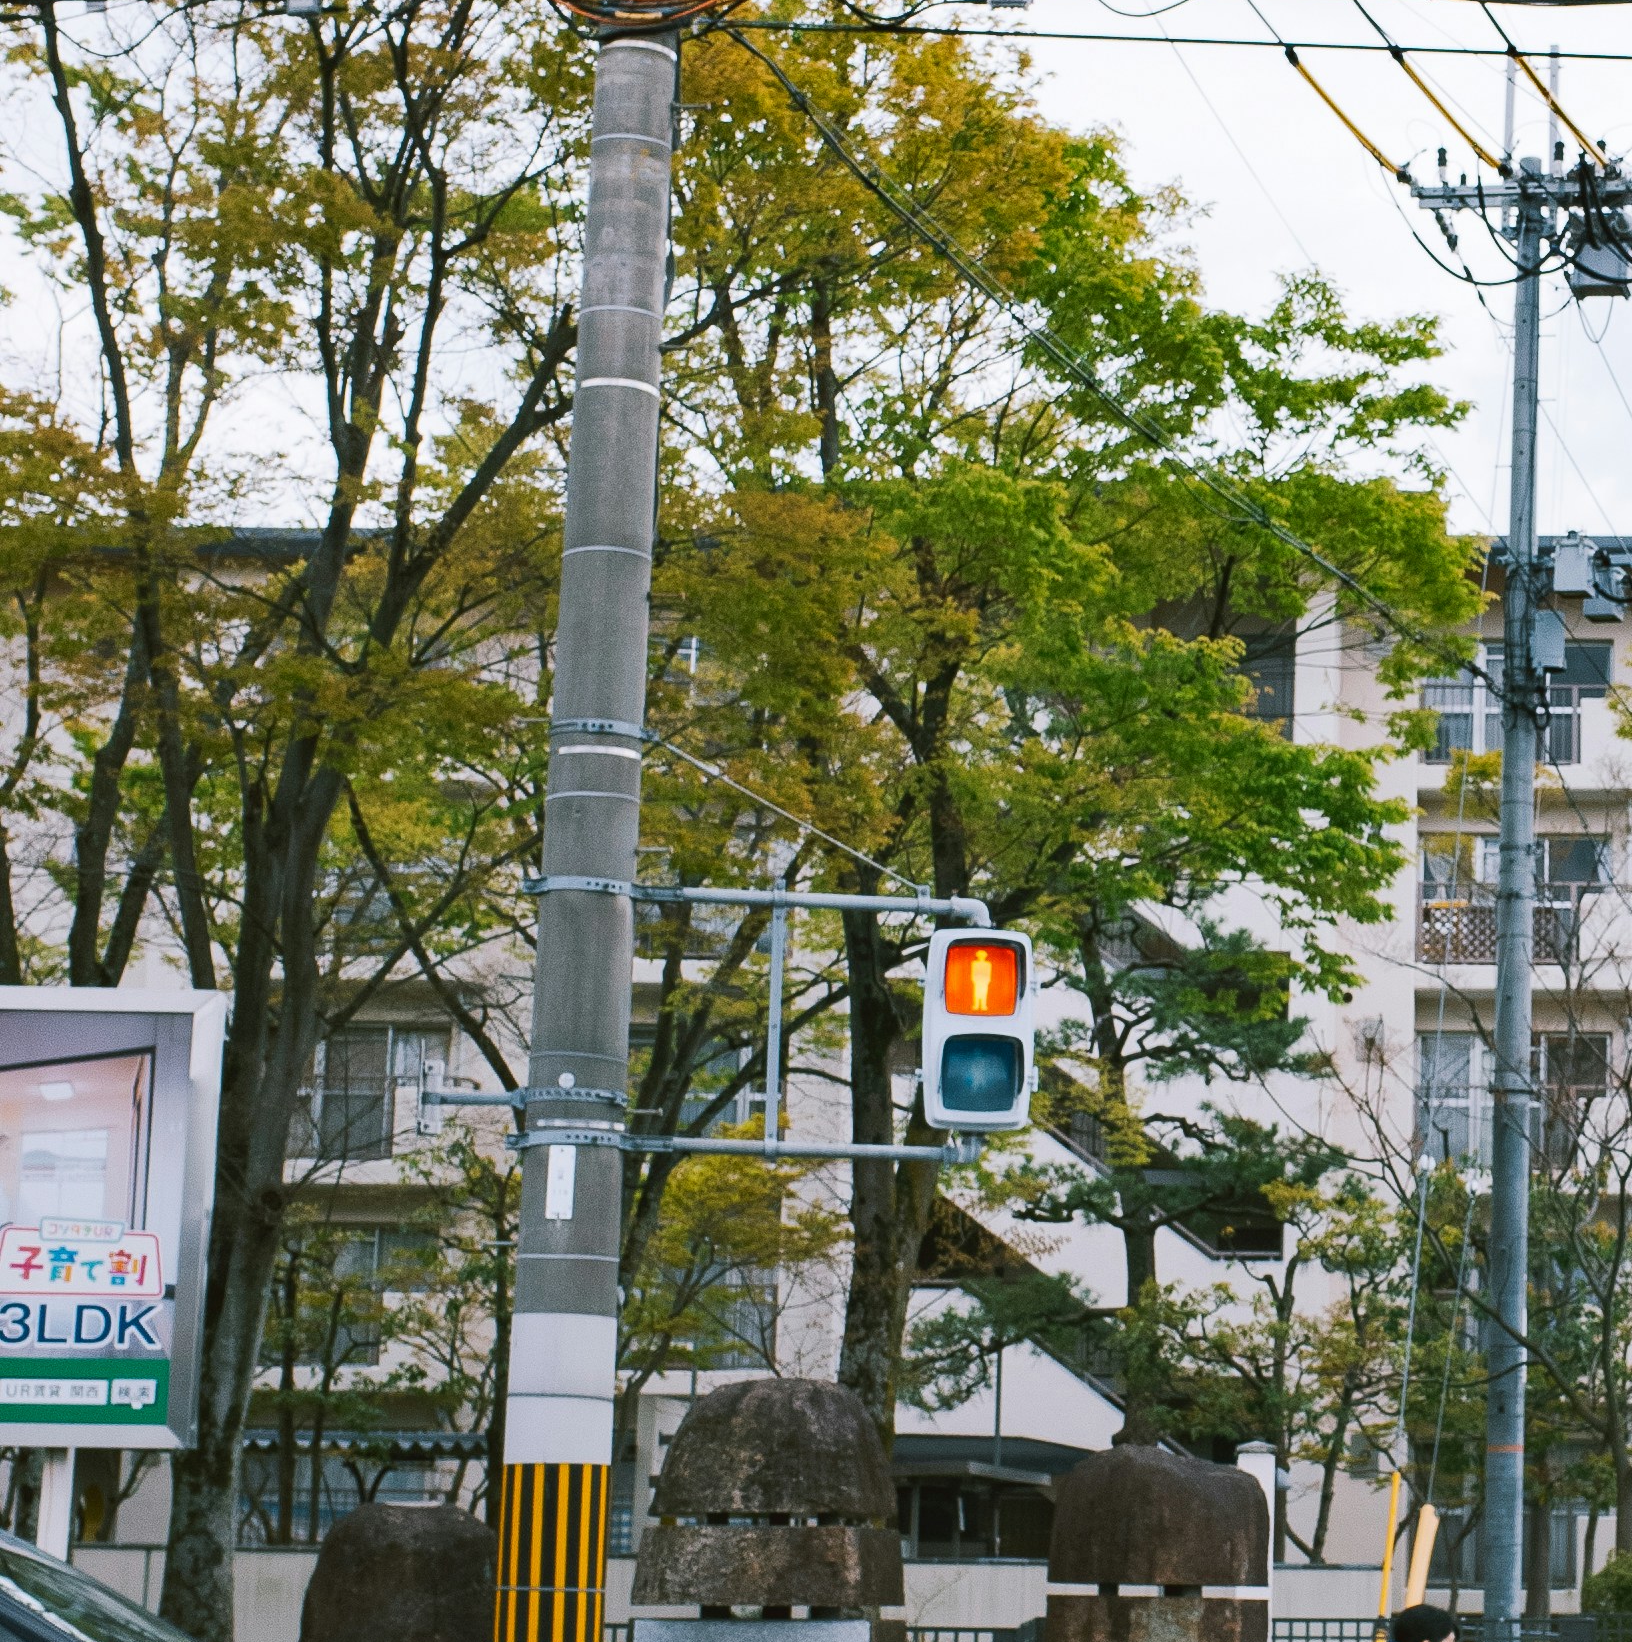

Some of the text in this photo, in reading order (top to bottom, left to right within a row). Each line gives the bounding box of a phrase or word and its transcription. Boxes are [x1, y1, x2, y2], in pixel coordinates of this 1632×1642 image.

[9, 1245, 148, 1286] 子育て割
[0, 1302, 157, 1345] 3LDK
